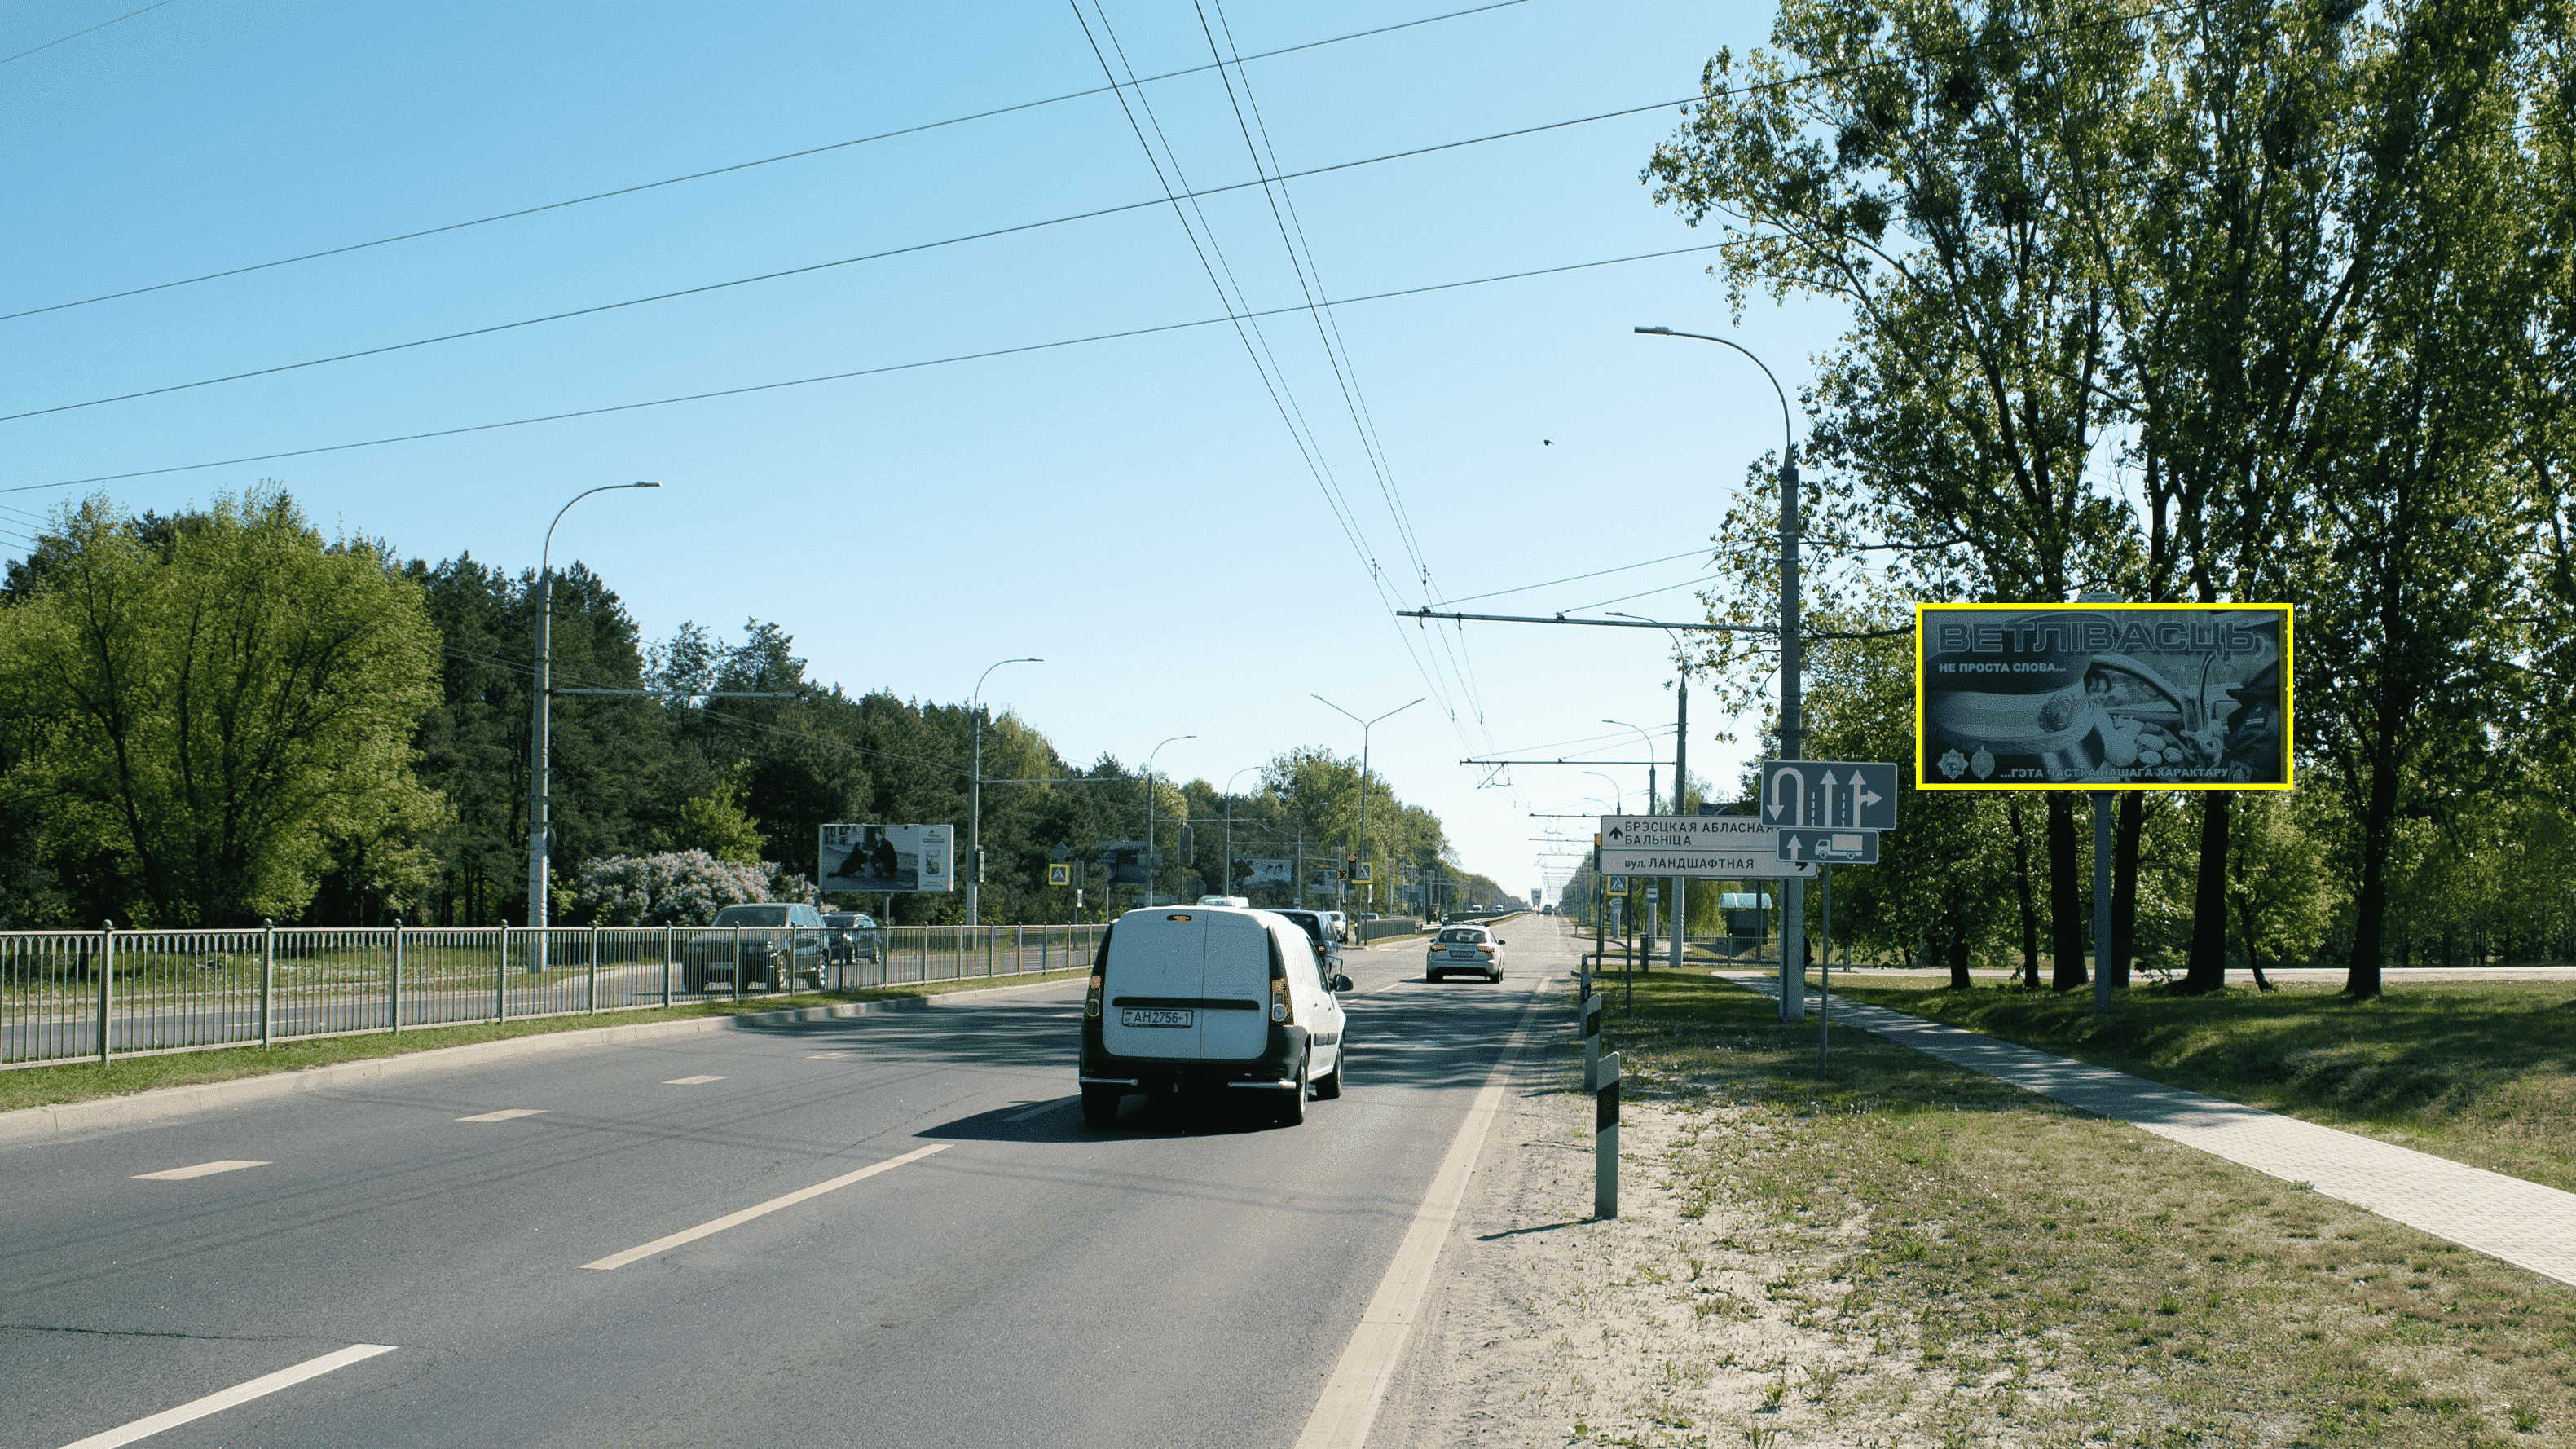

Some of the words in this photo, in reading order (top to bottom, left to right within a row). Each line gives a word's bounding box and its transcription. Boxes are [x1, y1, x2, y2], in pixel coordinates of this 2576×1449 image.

[1937, 621, 2257, 654] ВЕТЛІВАСЦЬ
[1939, 663, 1956, 672] НЕ
[1959, 663, 2010, 673] ПРОСТА
[2012, 662, 2067, 672] СЛОВА...
[2000, 768, 2044, 778] ...ГЭТА
[2046, 768, 2098, 778] ЧАСТКА
[2101, 768, 2154, 778] НАШАГА
[2156, 768, 2229, 778] ХАРАКТАРУ
[1625, 821, 1698, 834] БРЭСЦКАЯ
[1625, 834, 1692, 846] БАЛЬНІЦА
[1624, 859, 1646, 870] вул.
[1648, 857, 1755, 870] ЛАНДШАФТНАЯ
